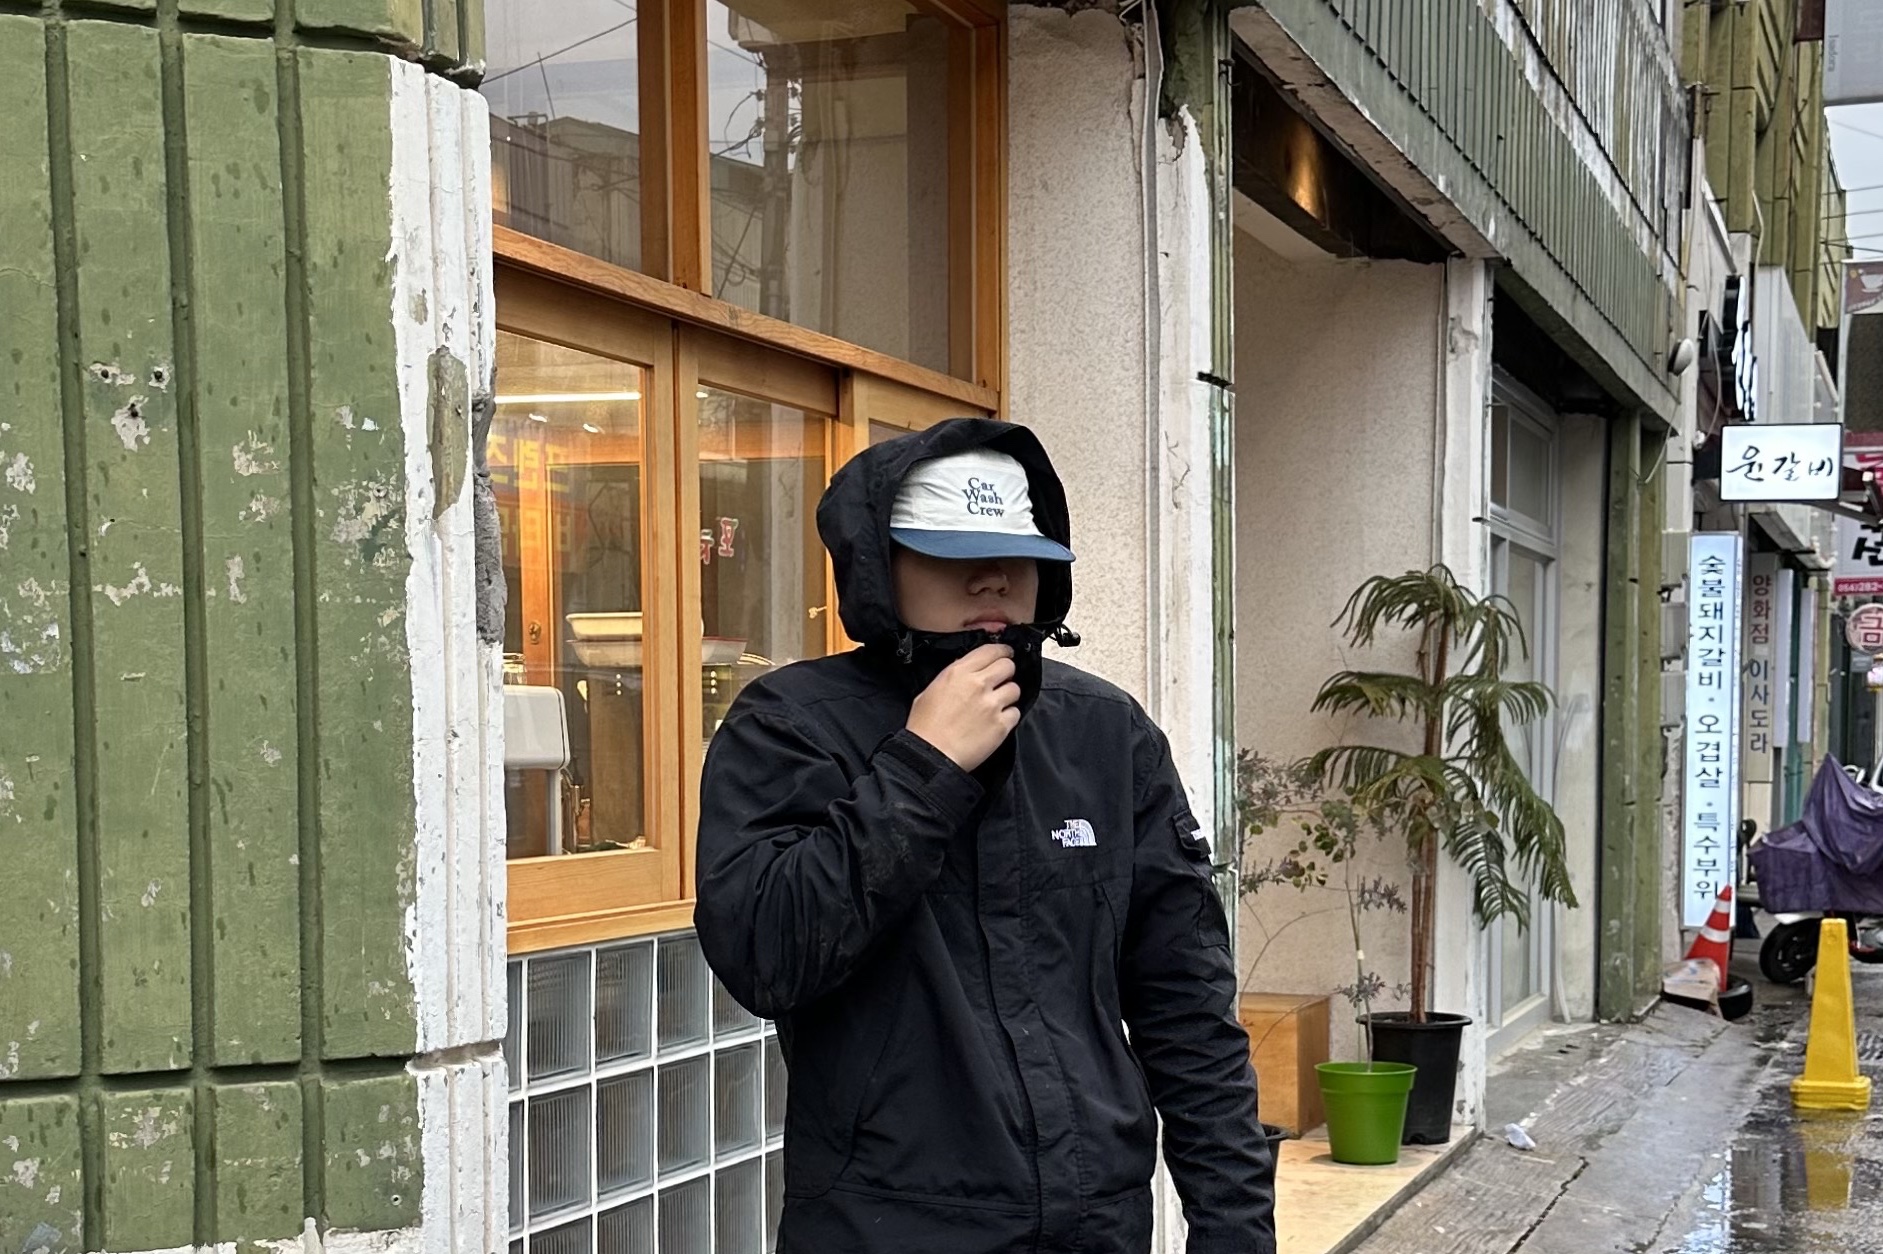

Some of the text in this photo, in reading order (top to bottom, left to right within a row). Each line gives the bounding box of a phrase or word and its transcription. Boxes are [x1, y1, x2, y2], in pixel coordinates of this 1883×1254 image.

[967, 477, 995, 491] Car
[961, 488, 1004, 505] Wash
[967, 501, 1005, 517] Crew
[1749, 574, 1772, 754] 양화점 이사도라
[1064, 819, 1081, 830] THE
[1051, 829, 1081, 840] NORTH
[1062, 838, 1082, 848] FACE
